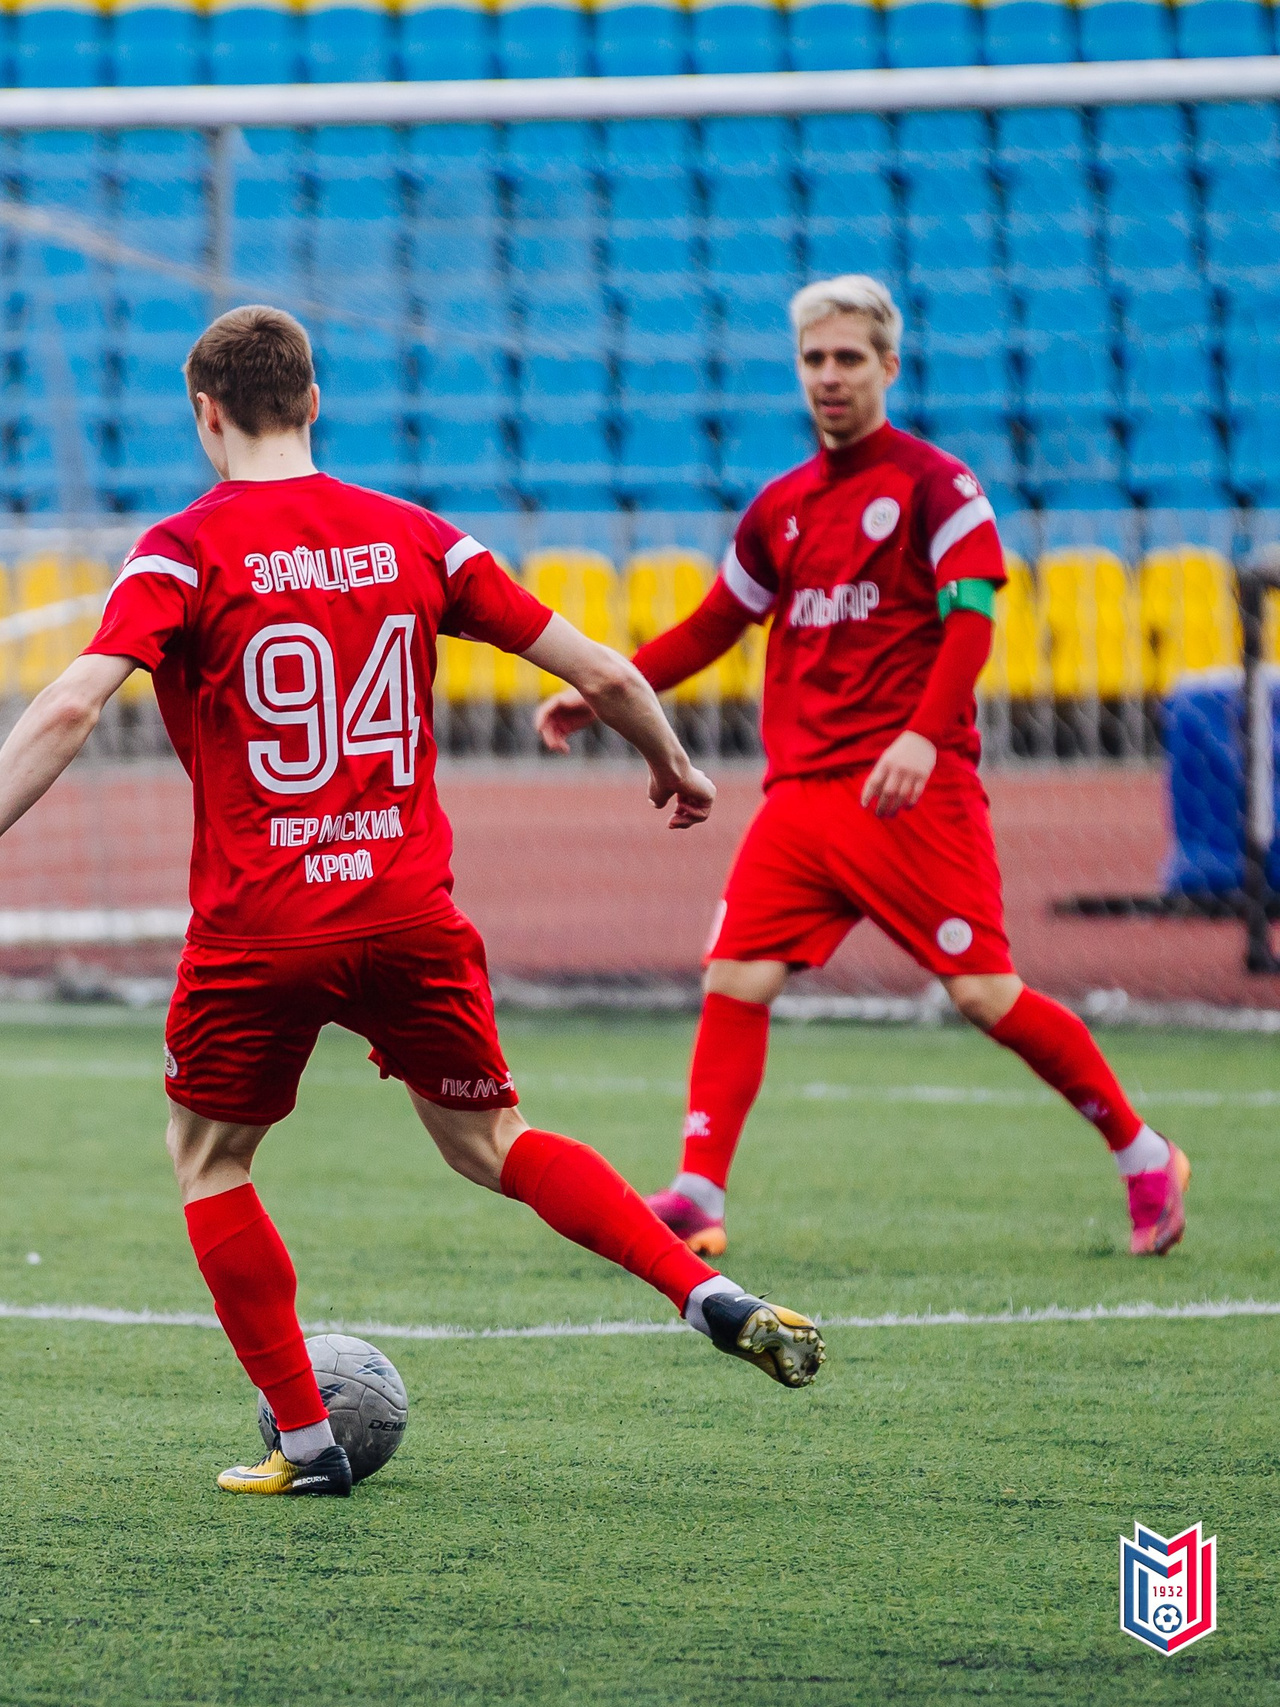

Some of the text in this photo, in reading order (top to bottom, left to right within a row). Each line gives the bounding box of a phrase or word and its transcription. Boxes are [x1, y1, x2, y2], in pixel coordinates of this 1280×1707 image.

[244, 542, 399, 594] ЗАЙЦЕВ
[244, 614, 421, 794] 94
[270, 806, 404, 847] ПЕРМСКИЙ
[304, 849, 374, 883] КРАЙ
